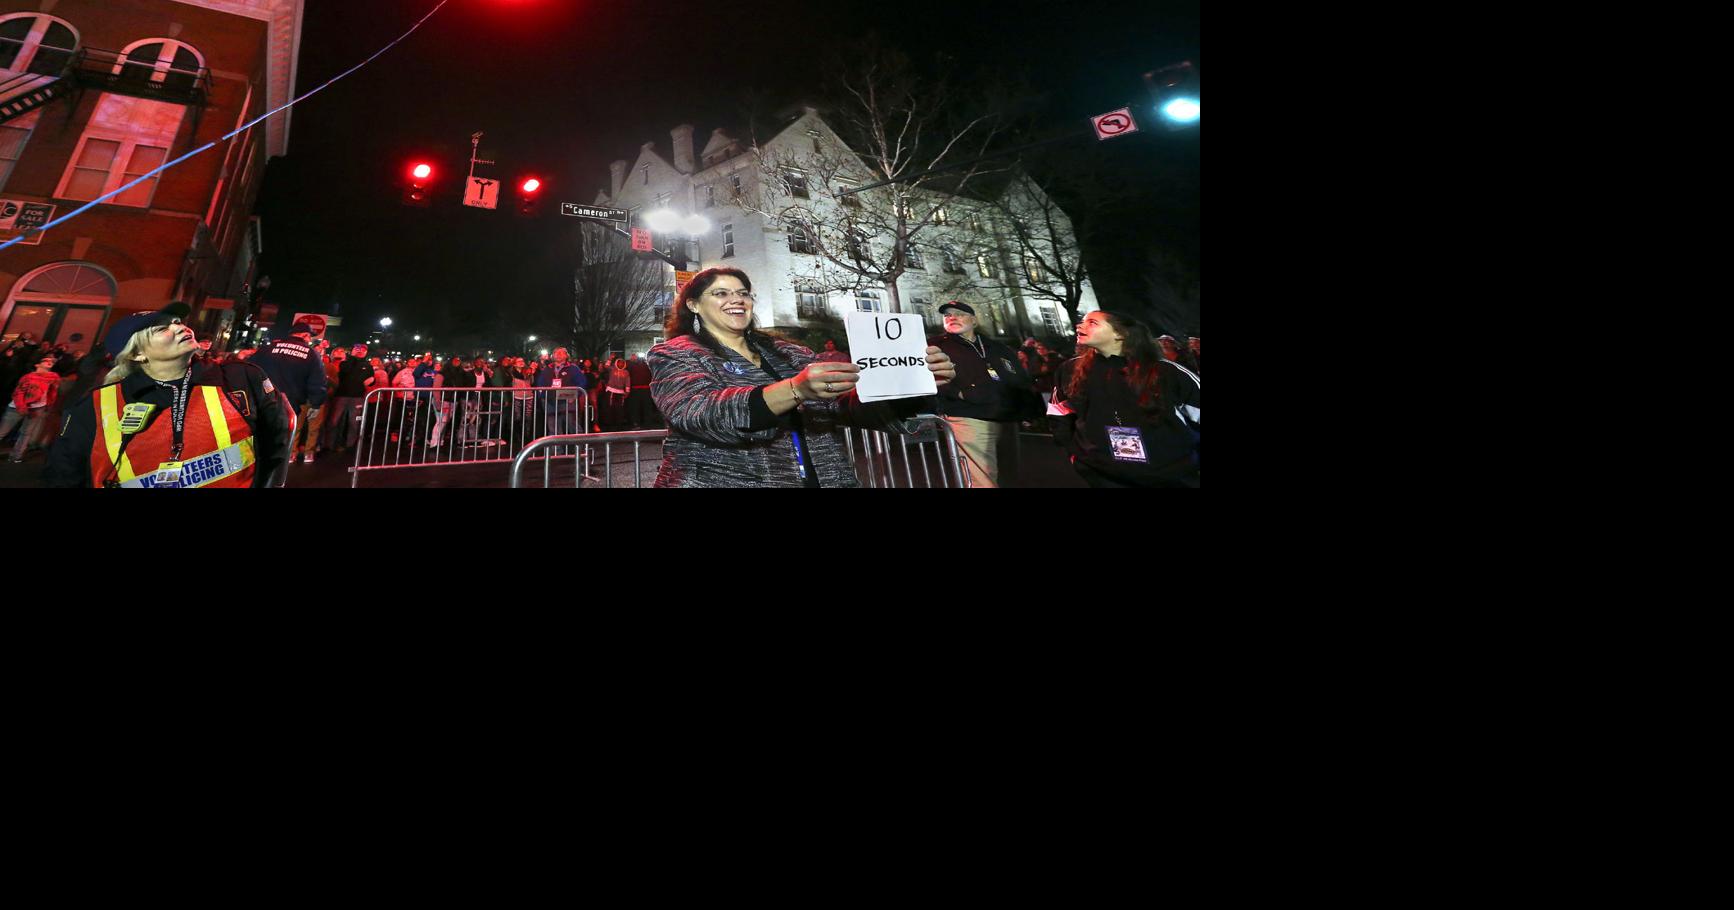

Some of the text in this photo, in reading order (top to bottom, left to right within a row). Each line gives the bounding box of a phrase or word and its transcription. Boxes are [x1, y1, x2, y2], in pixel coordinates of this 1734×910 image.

[573, 206, 609, 218] Cameron
[875, 316, 903, 340] 10
[276, 342, 310, 354] VOLUNTEER
[279, 348, 308, 360] POLICING
[856, 356, 925, 370] SECONDS
[177, 389, 187, 421] VOLUNTEERS
